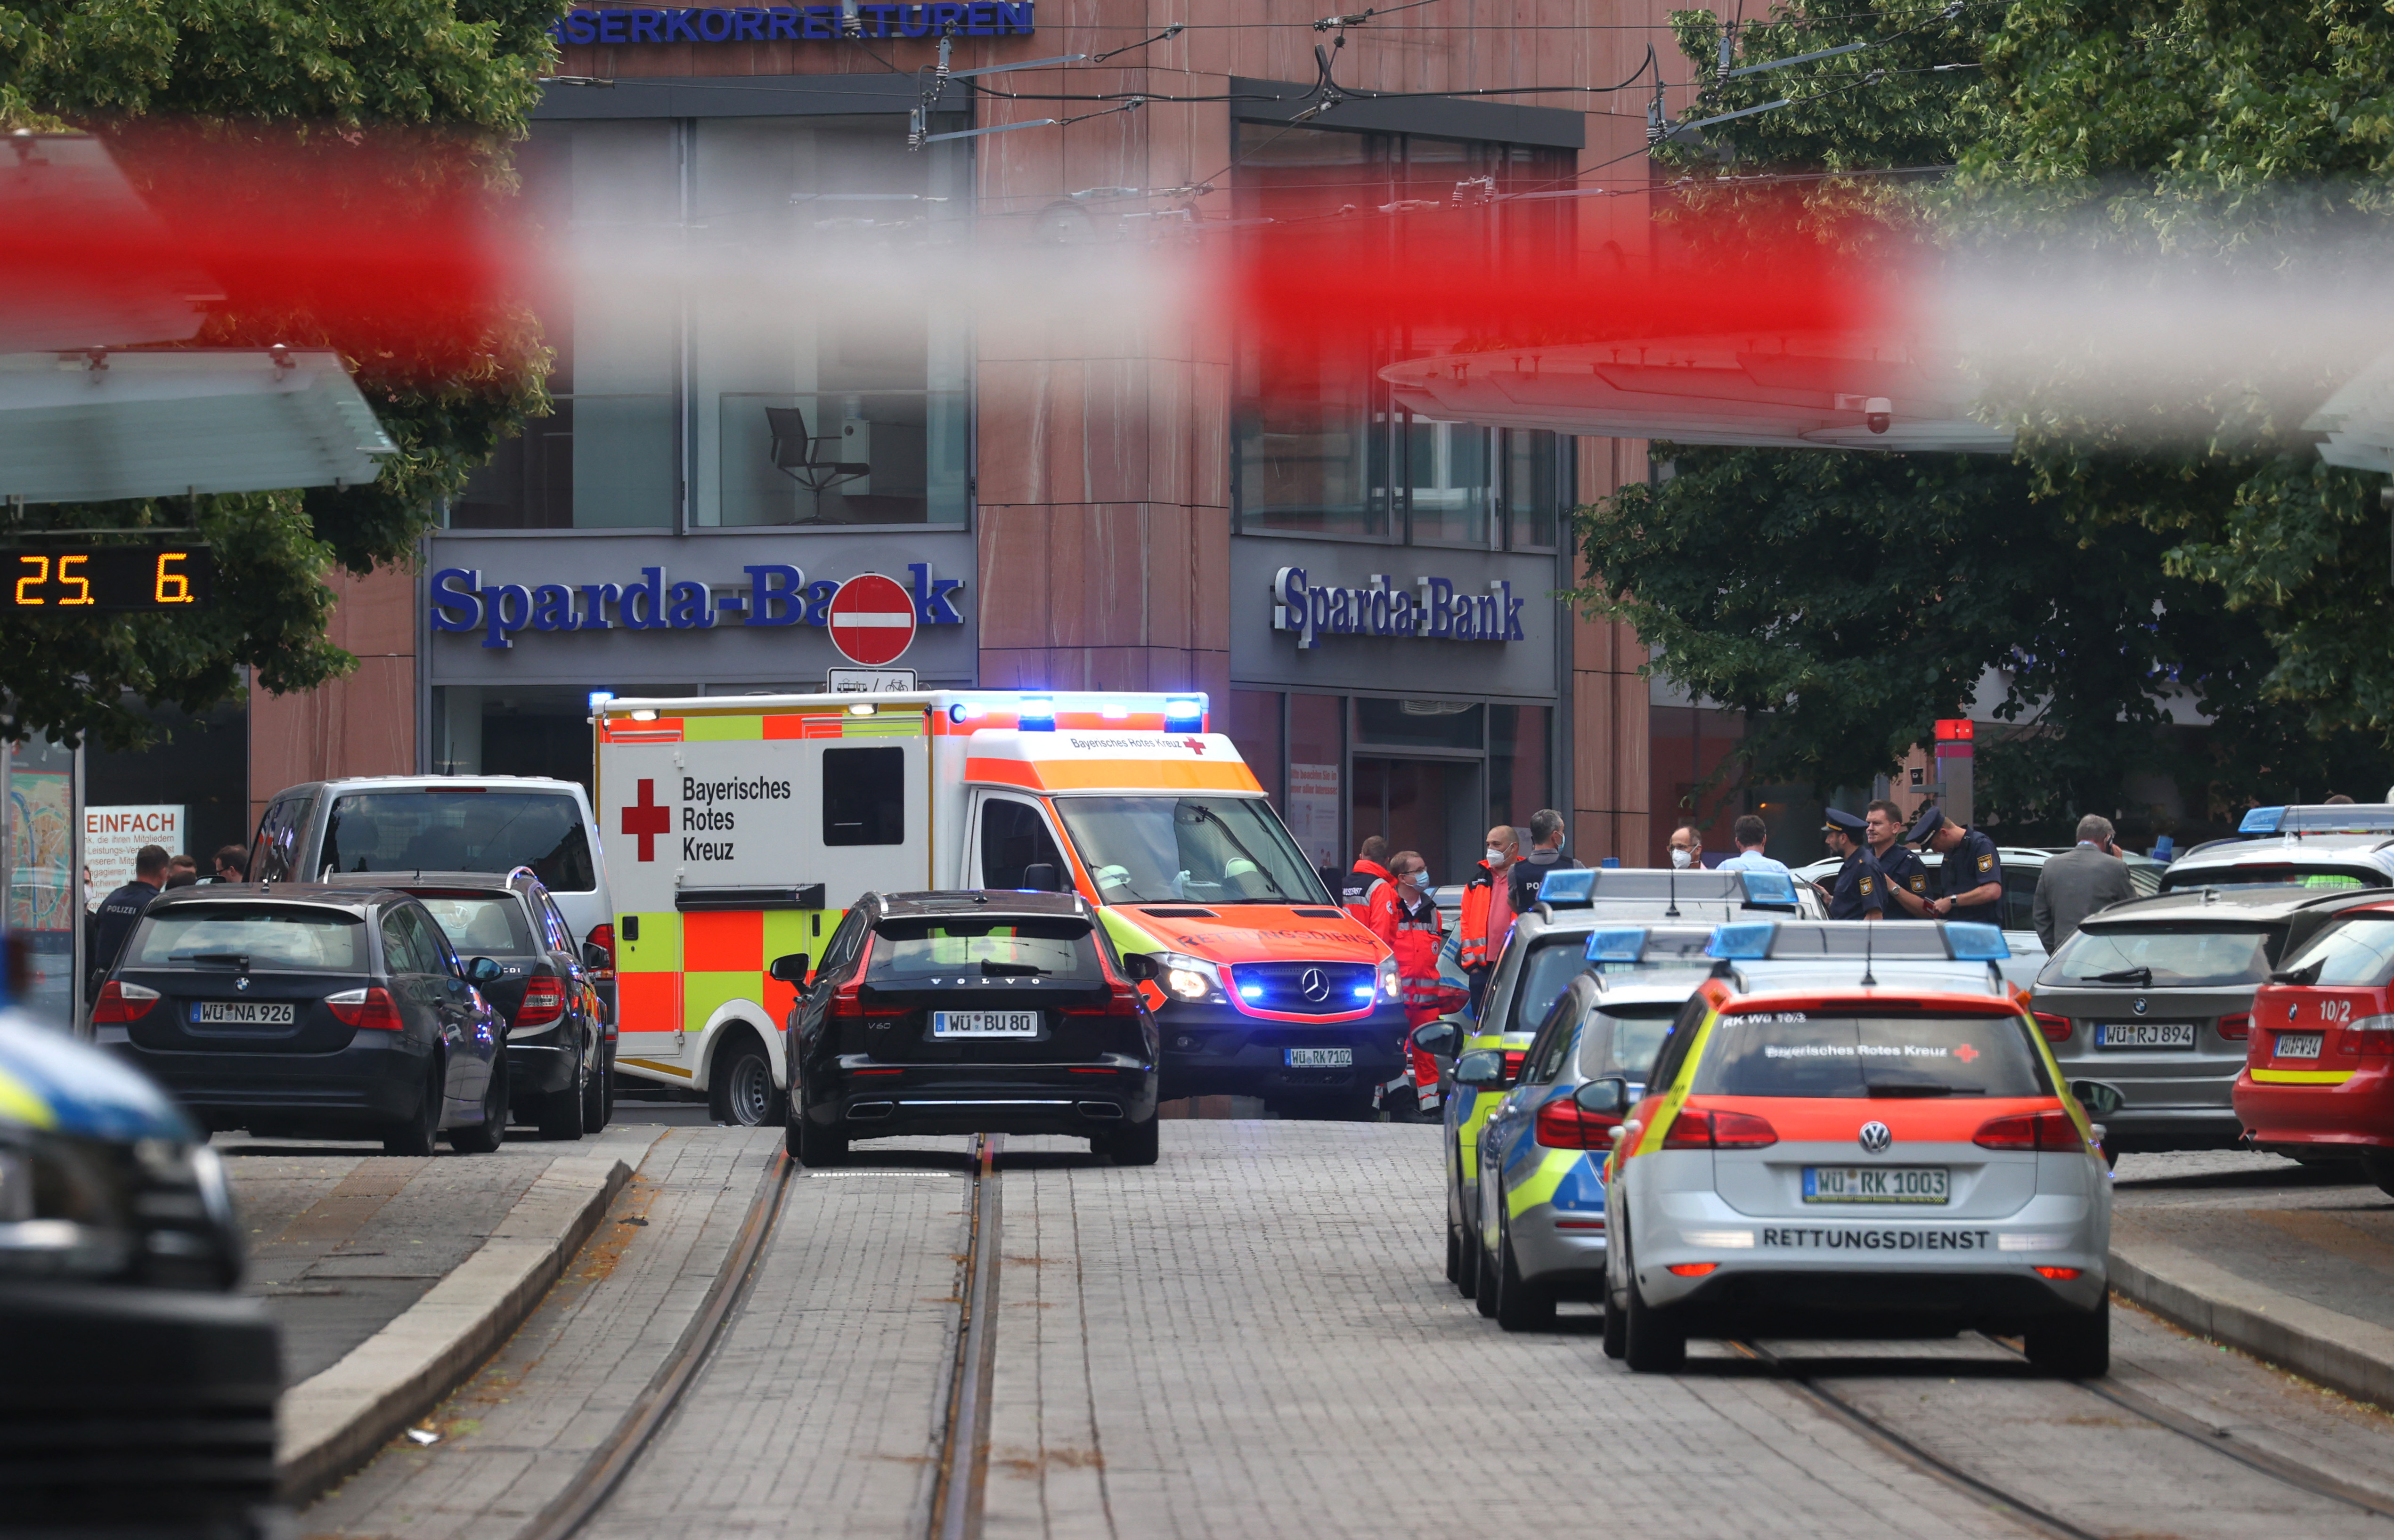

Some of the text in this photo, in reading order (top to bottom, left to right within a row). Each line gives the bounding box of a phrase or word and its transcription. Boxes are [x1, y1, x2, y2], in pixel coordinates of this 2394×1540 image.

[430, 562, 965, 648] Sparda-Bak
[1274, 567, 1524, 648] Sparda-Bank
[1070, 738, 1182, 749] Bayerisches Rotes Kreuz
[683, 776, 790, 806] Bayerisches
[87, 813, 174, 833] EINFACH
[683, 807, 734, 831] Rotes
[683, 837, 734, 861] Kreuz
[107, 905, 137, 914] POLIZEI
[1177, 930, 1379, 949] RETTUNGSDIENST
[2320, 1000, 2351, 1022] 10/2
[1723, 1015, 1745, 1029] RK
[1857, 1044, 1901, 1056] Rotes
[1904, 1045, 1947, 1057] Kreuz
[1764, 1229, 1990, 1249] RETTUNGSDIENST
